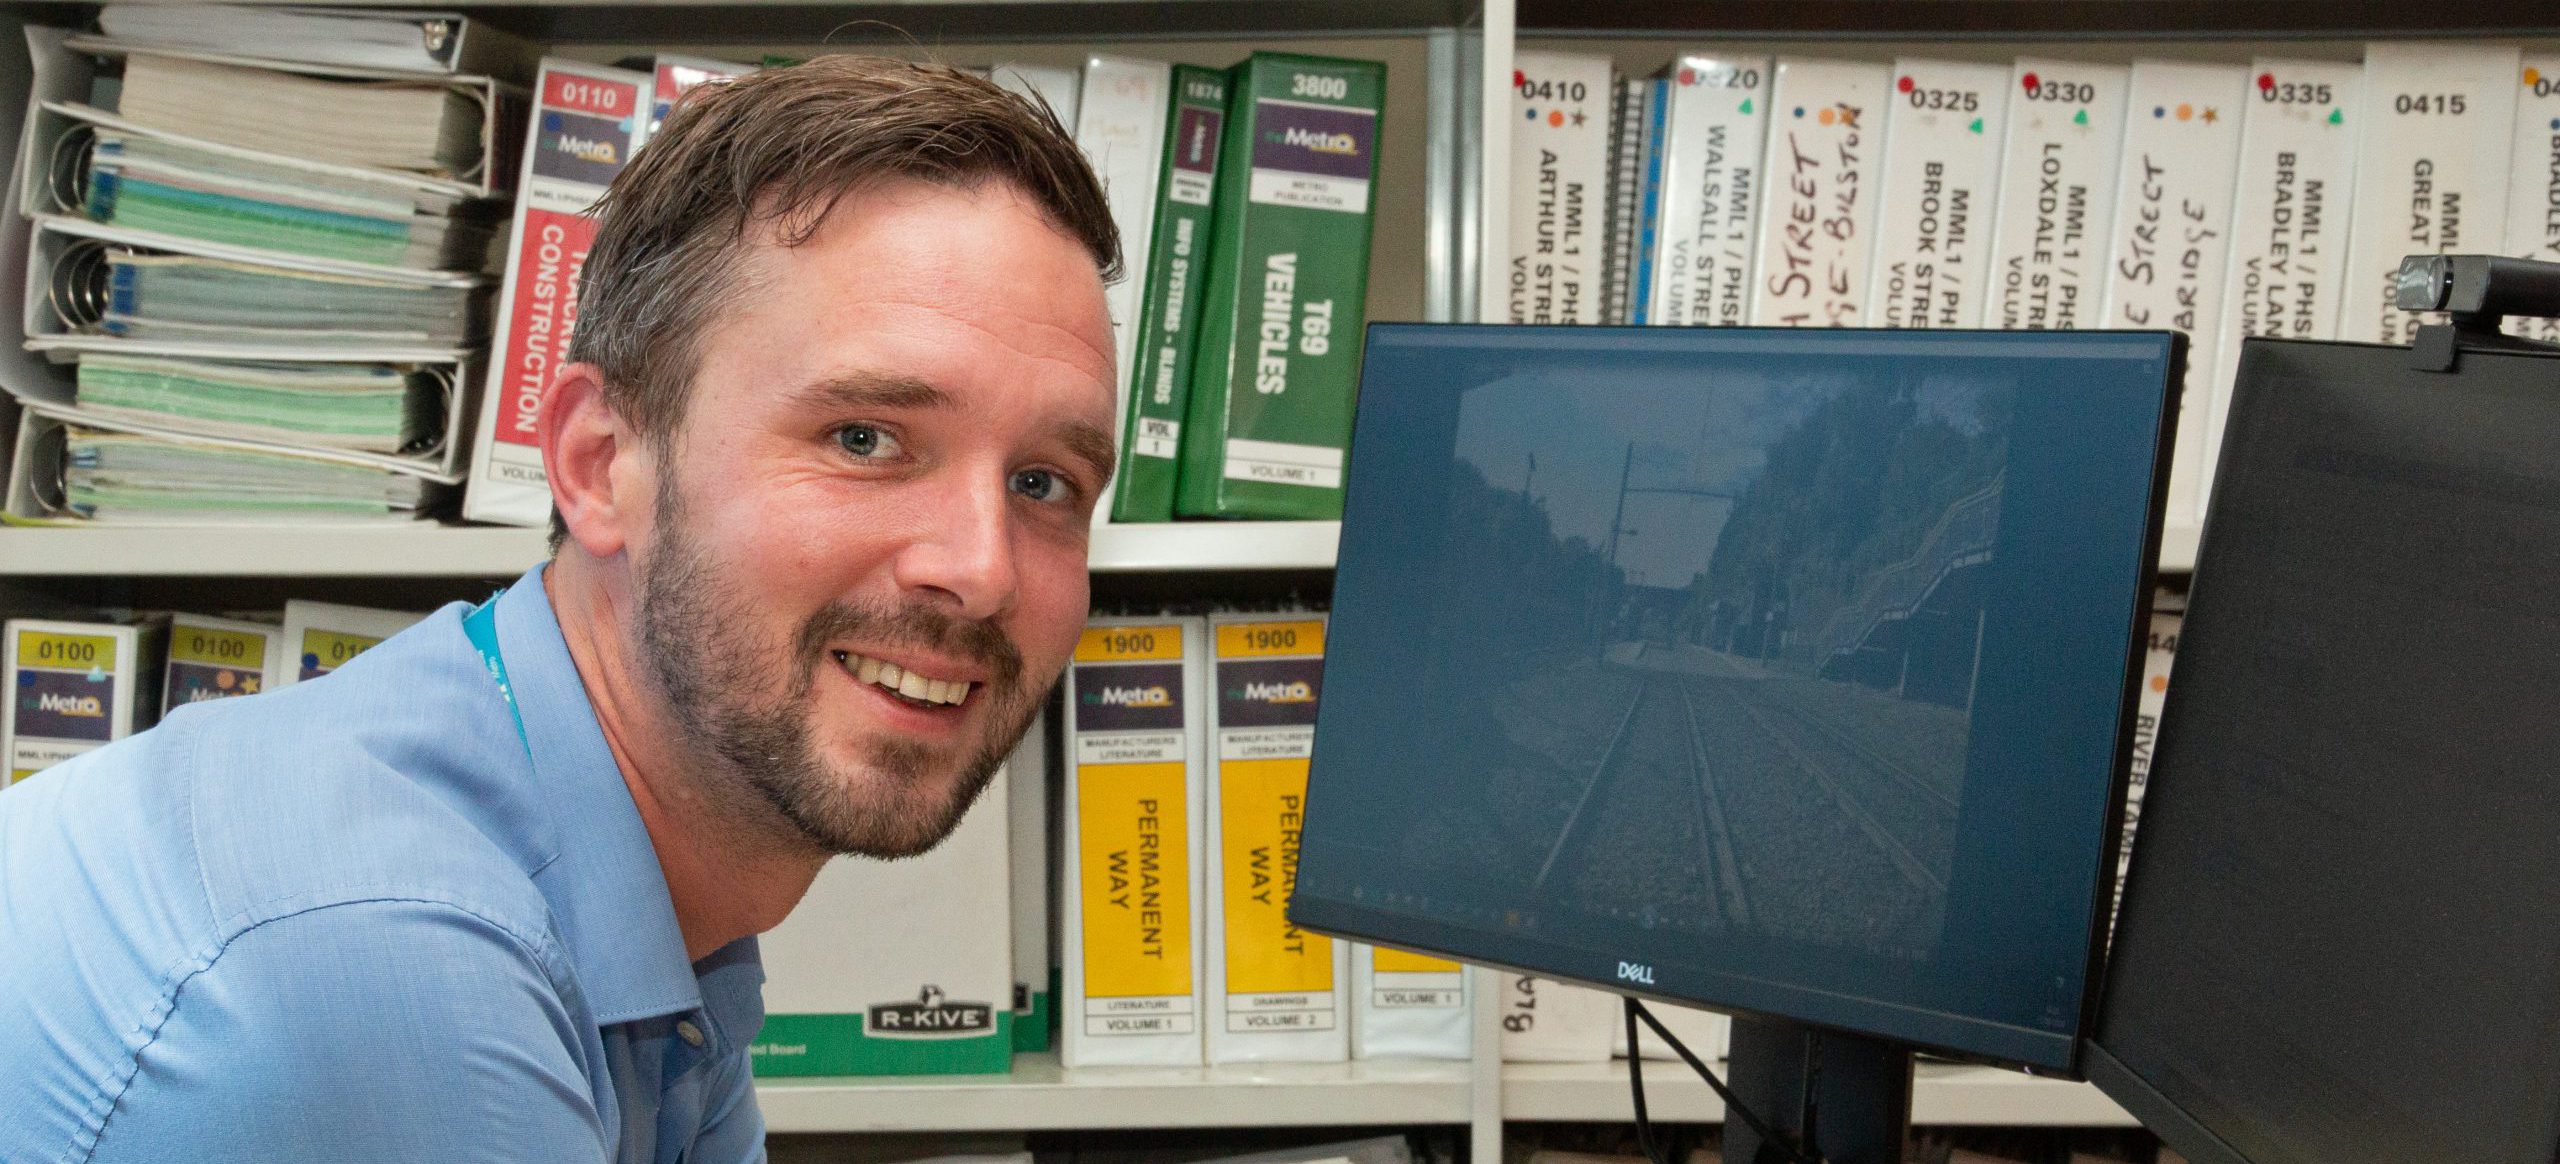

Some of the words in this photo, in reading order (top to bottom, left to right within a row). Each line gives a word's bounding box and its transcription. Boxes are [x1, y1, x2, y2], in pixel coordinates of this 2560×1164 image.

[562, 81, 617, 110] 0110
[1291, 74, 1348, 100] 3800
[1521, 80, 1586, 101] 0410
[2025, 81, 2095, 104] 0330
[2262, 83, 2332, 105] 0335
[1909, 88, 1979, 113] 0325
[2395, 93, 2466, 116] 0415
[1697, 124, 1726, 246] WALSALL
[1536, 149, 1558, 254] ARTHUR
[1917, 161, 1944, 253] BROOK
[2033, 142, 2062, 264] LOXDALE
[2269, 152, 2296, 276] BRADLEY
[2411, 159, 2434, 246] GREAT
[1767, 132, 1820, 298] STREET
[2118, 153, 2165, 286] STREET
[515, 224, 565, 433] CONSTRUCTION
[1256, 252, 1297, 395] VEHICLES
[1301, 299, 1333, 356] T69
[1147, 422, 1170, 437] VOL
[1153, 441, 1159, 452] 1
[1250, 465, 1305, 480] VOLUME
[1309, 470, 1316, 481] 1
[39, 640, 95, 662] 0100
[191, 637, 245, 660] 0100
[1103, 634, 1155, 654] 1900
[1245, 630, 1297, 649] 1900
[1100, 749, 1163, 760] LITERATURE
[2129, 714, 2155, 787] RIVER
[1108, 849, 1131, 910] WAY
[1138, 799, 1163, 960] PERMANENT
[1250, 846, 1272, 906] WAY
[1617, 961, 1656, 985] DELL
[1383, 993, 1437, 1005] VOLUME
[1445, 993, 1451, 1004] 1
[881, 1009, 980, 1028] R-KIVE
[1107, 1018, 1161, 1031] VOLUME
[1166, 1019, 1172, 1029] 1
[1246, 1014, 1301, 1027] VOLUME
[1308, 1015, 1316, 1025] 2
